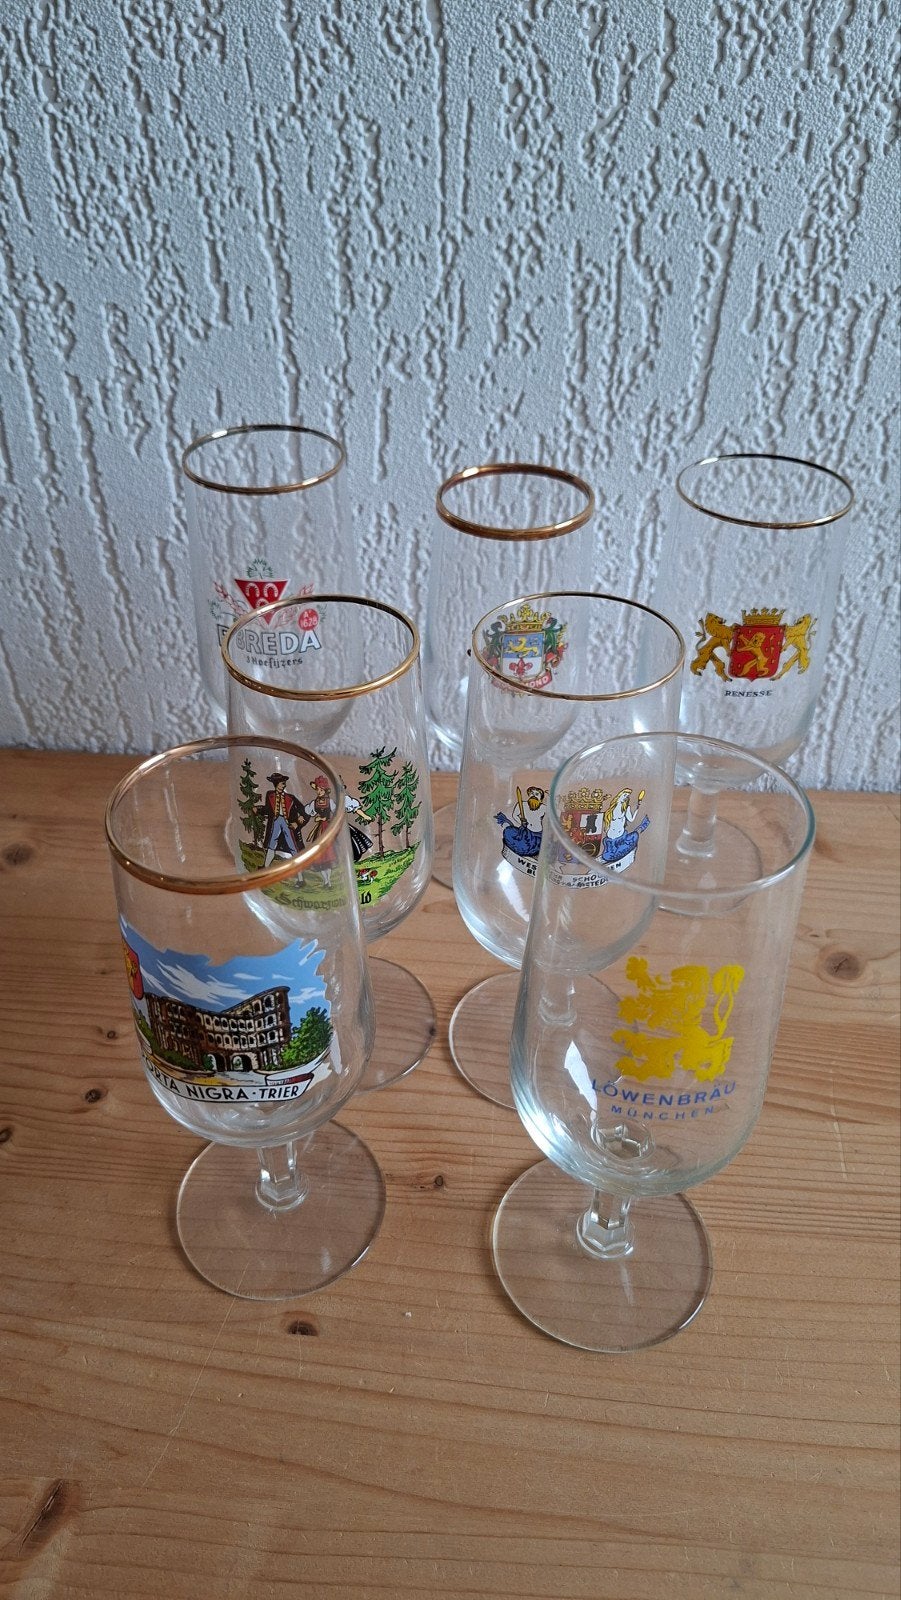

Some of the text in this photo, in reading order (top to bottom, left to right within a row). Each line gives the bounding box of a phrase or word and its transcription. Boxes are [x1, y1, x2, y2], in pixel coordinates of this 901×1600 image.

[233, 629, 322, 655] BREDA
[724, 690, 774, 698] RENESSE
[142, 1054, 300, 1100] ORTA NIGRA TRIER
[591, 1078, 736, 1106] LÖWENBRÄU
[611, 1104, 715, 1121] MÜNCHEN
